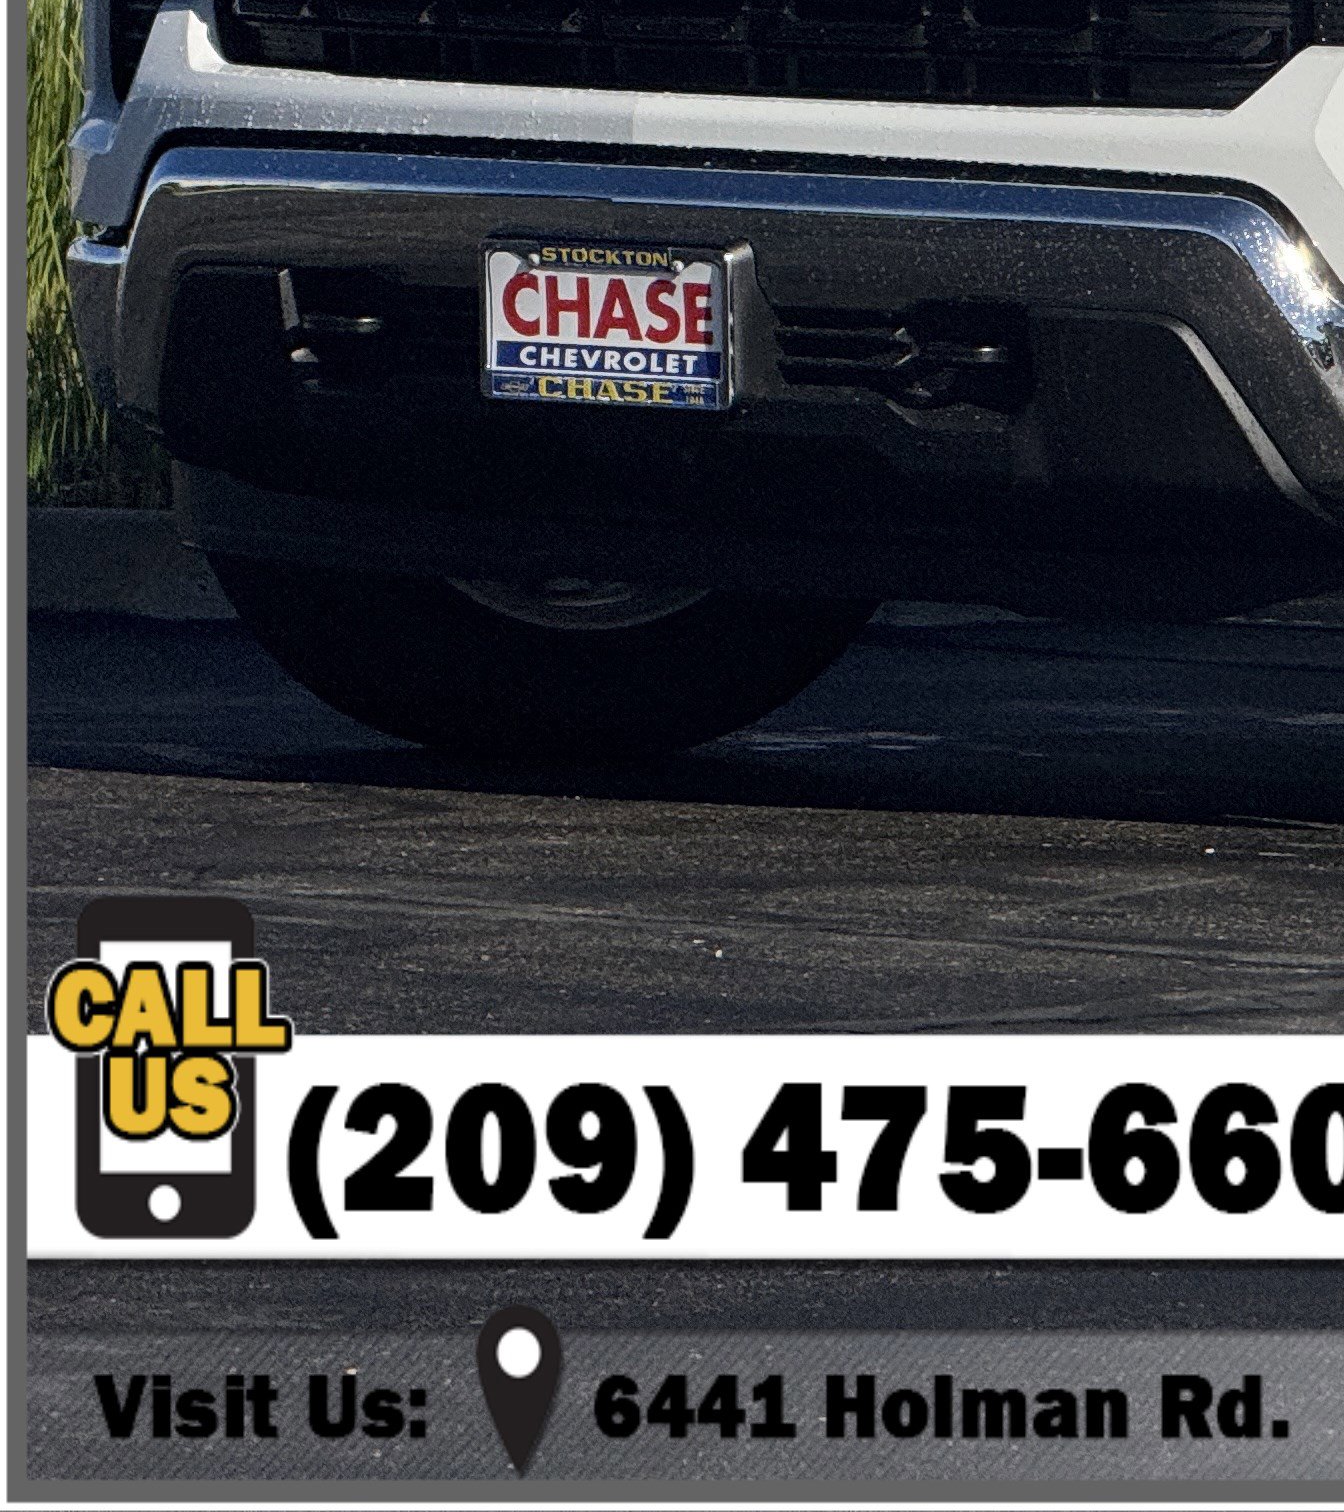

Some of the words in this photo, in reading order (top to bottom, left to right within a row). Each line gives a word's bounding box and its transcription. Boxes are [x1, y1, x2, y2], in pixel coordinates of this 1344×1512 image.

[541, 246, 669, 266] STOCKTON
[502, 271, 714, 345] CHASE
[519, 345, 698, 375] CHEVROLET
[536, 374, 675, 405] CHASE
